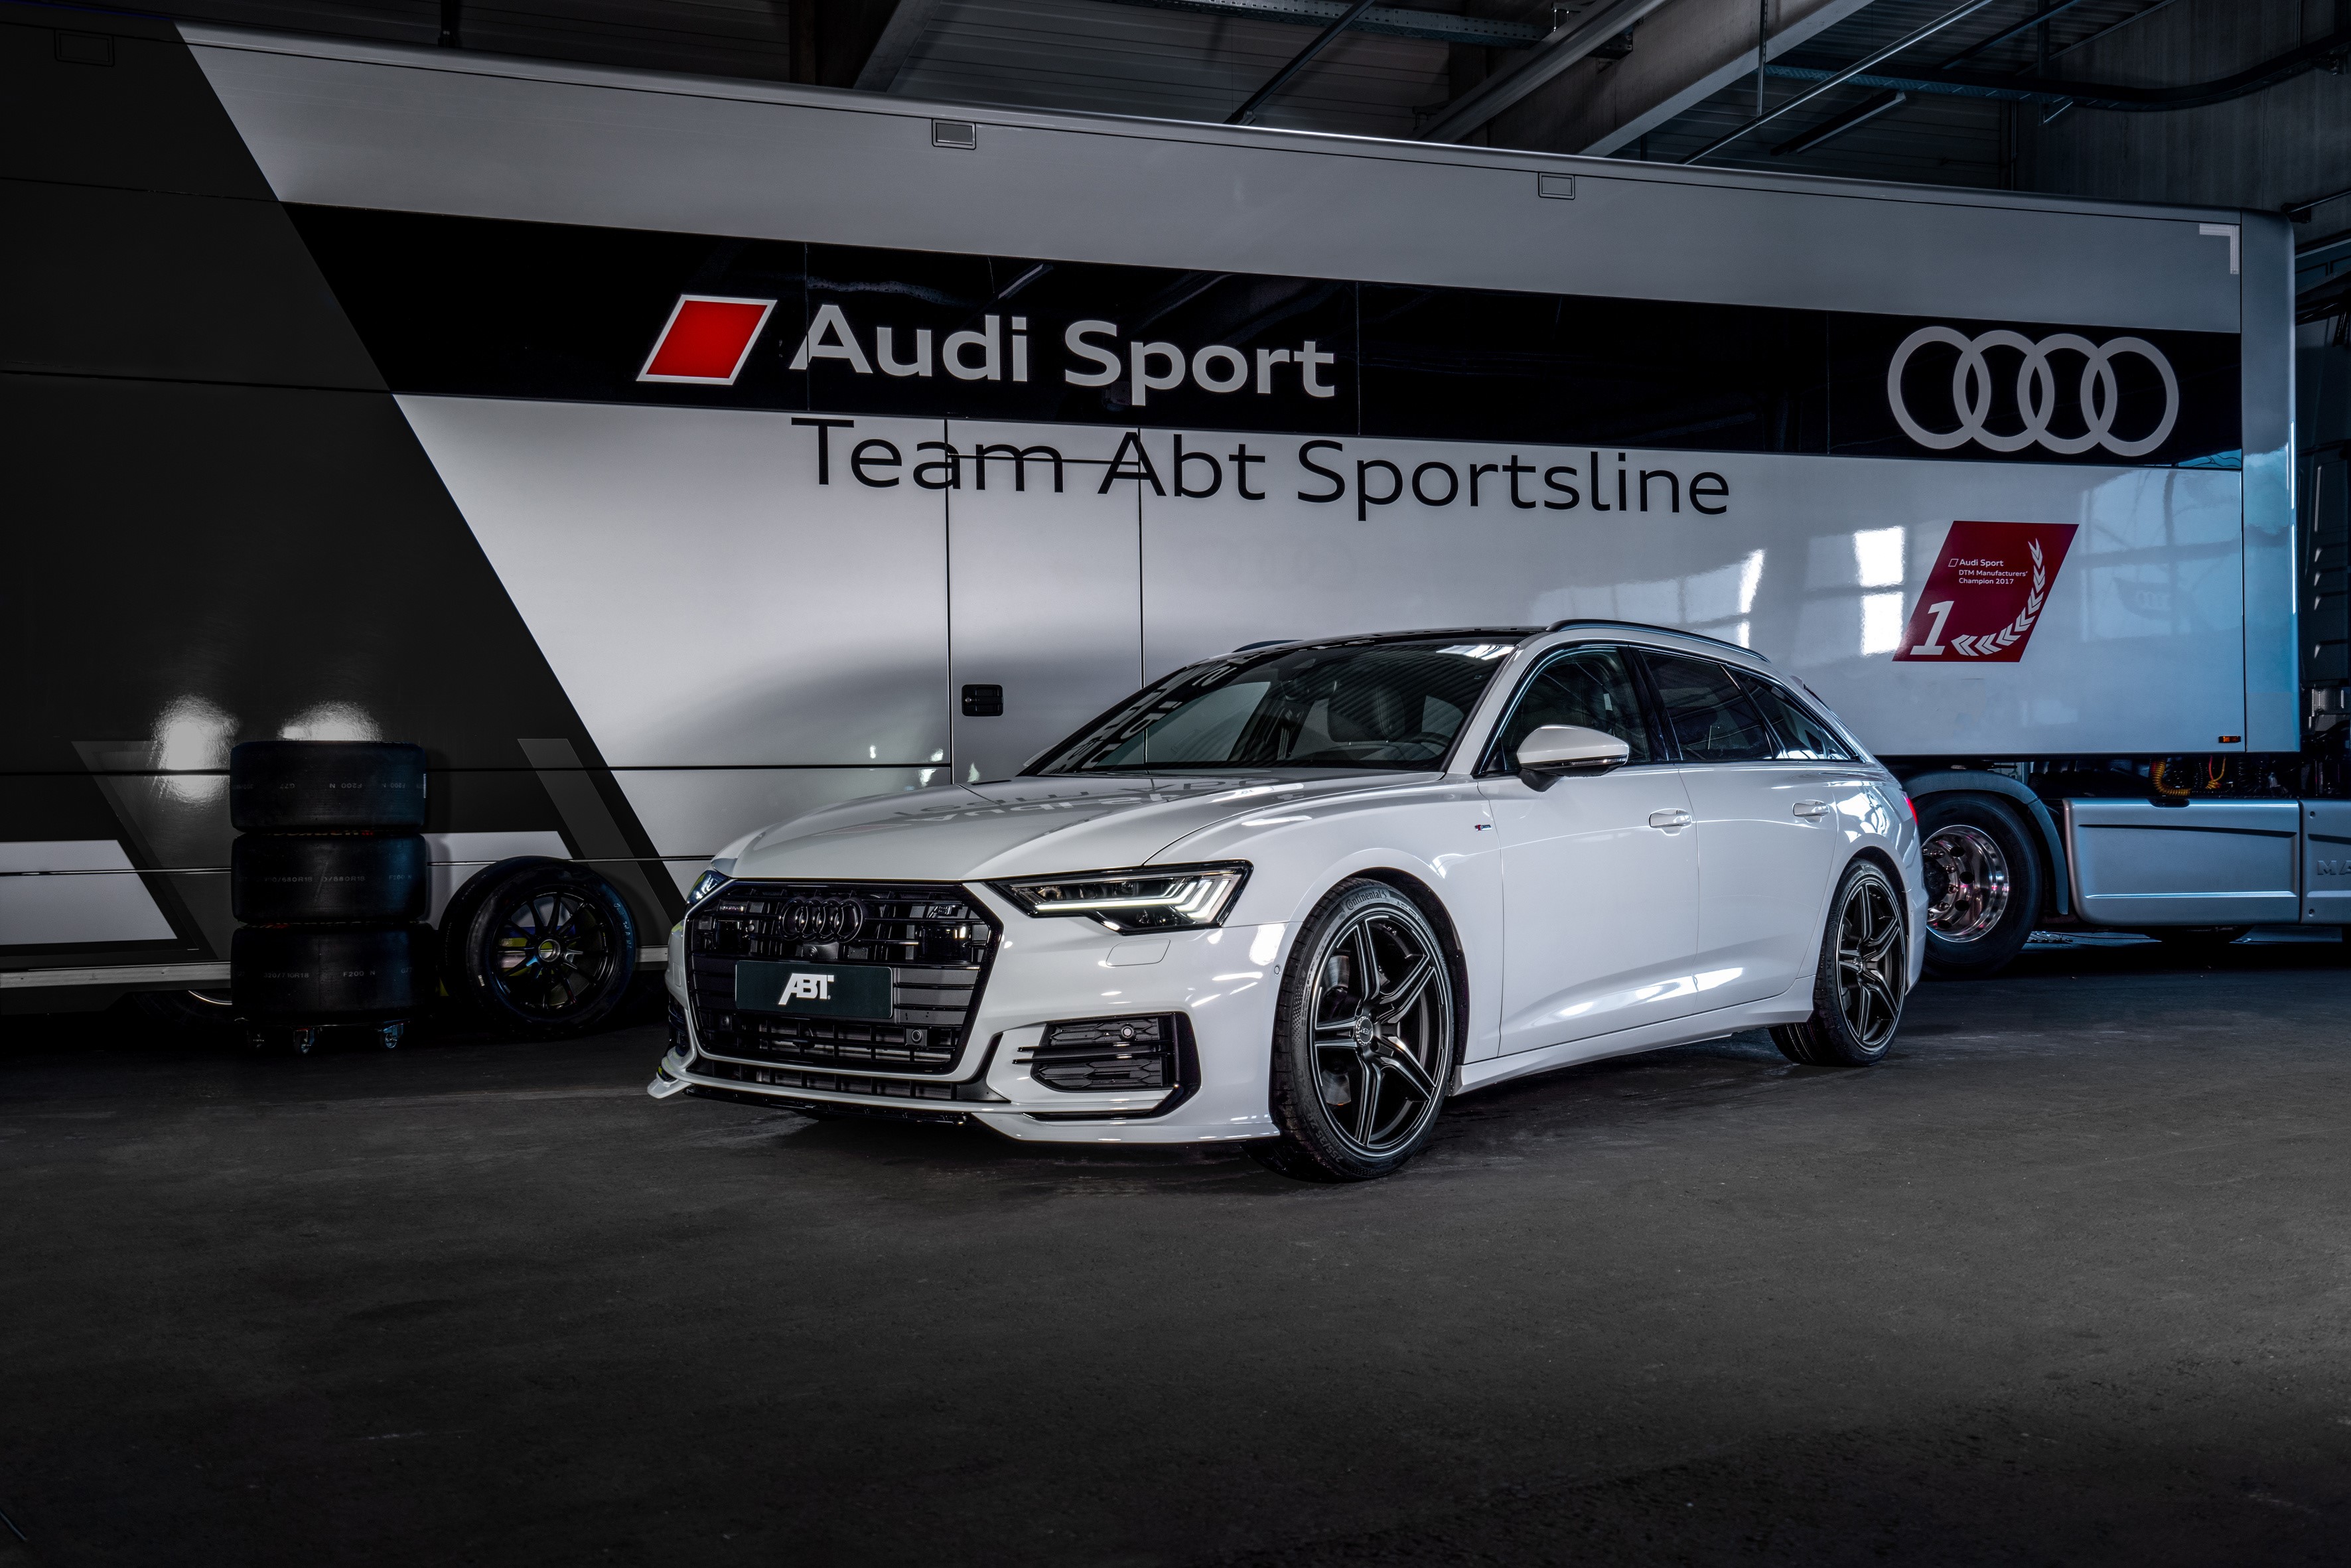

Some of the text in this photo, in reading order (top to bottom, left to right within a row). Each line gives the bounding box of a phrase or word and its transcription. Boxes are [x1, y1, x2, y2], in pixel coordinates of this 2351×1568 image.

[788, 303, 1335, 407] Audi Sport
[791, 417, 1729, 522] Team Abt Sportsline
[1980, 559, 2004, 567] Sport
[1910, 601, 1954, 655] 1
[1345, 890, 1382, 910] Continental
[778, 973, 835, 1005] ABT
